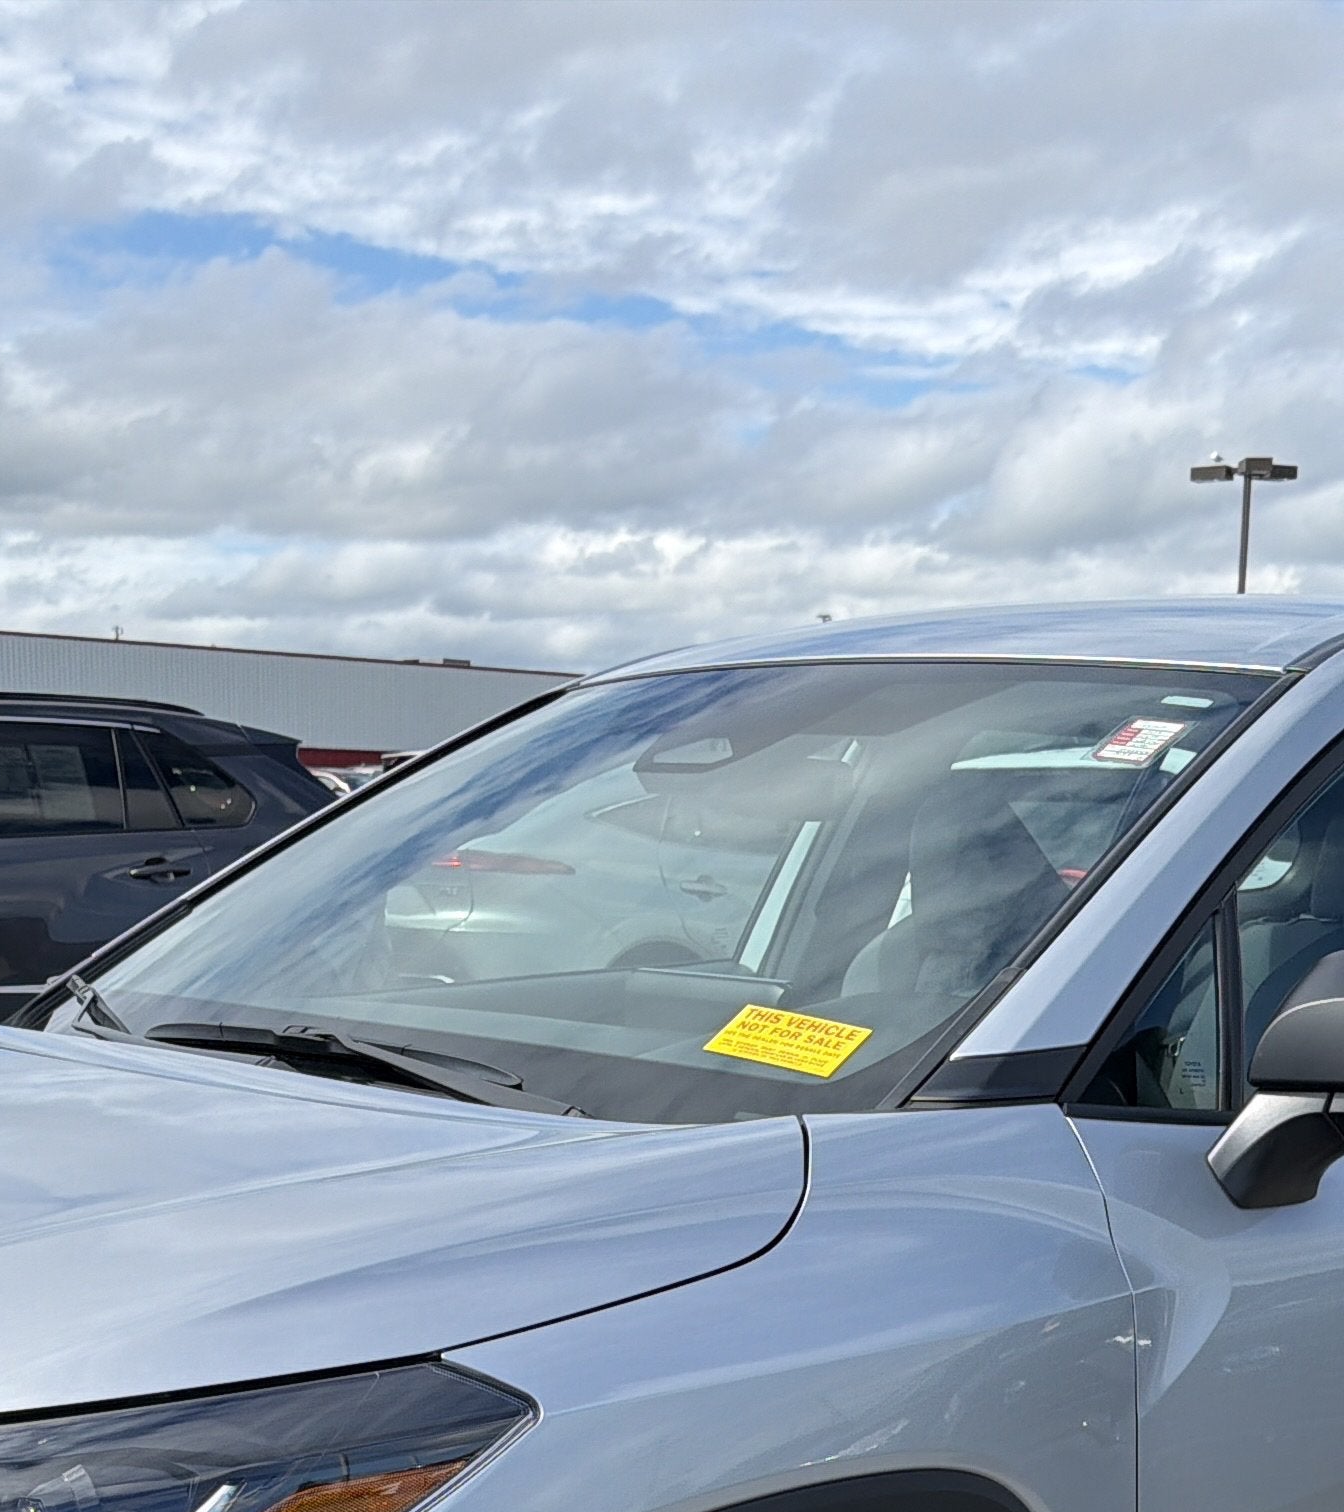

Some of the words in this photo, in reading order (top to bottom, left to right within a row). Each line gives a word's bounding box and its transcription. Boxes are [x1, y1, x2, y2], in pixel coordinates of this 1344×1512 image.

[736, 1021, 769, 1034] NOT
[769, 1027, 803, 1041] FOR
[803, 1034, 846, 1051] SALE
[745, 1008, 784, 1024] THIS
[786, 1016, 862, 1041] VEHICLE
